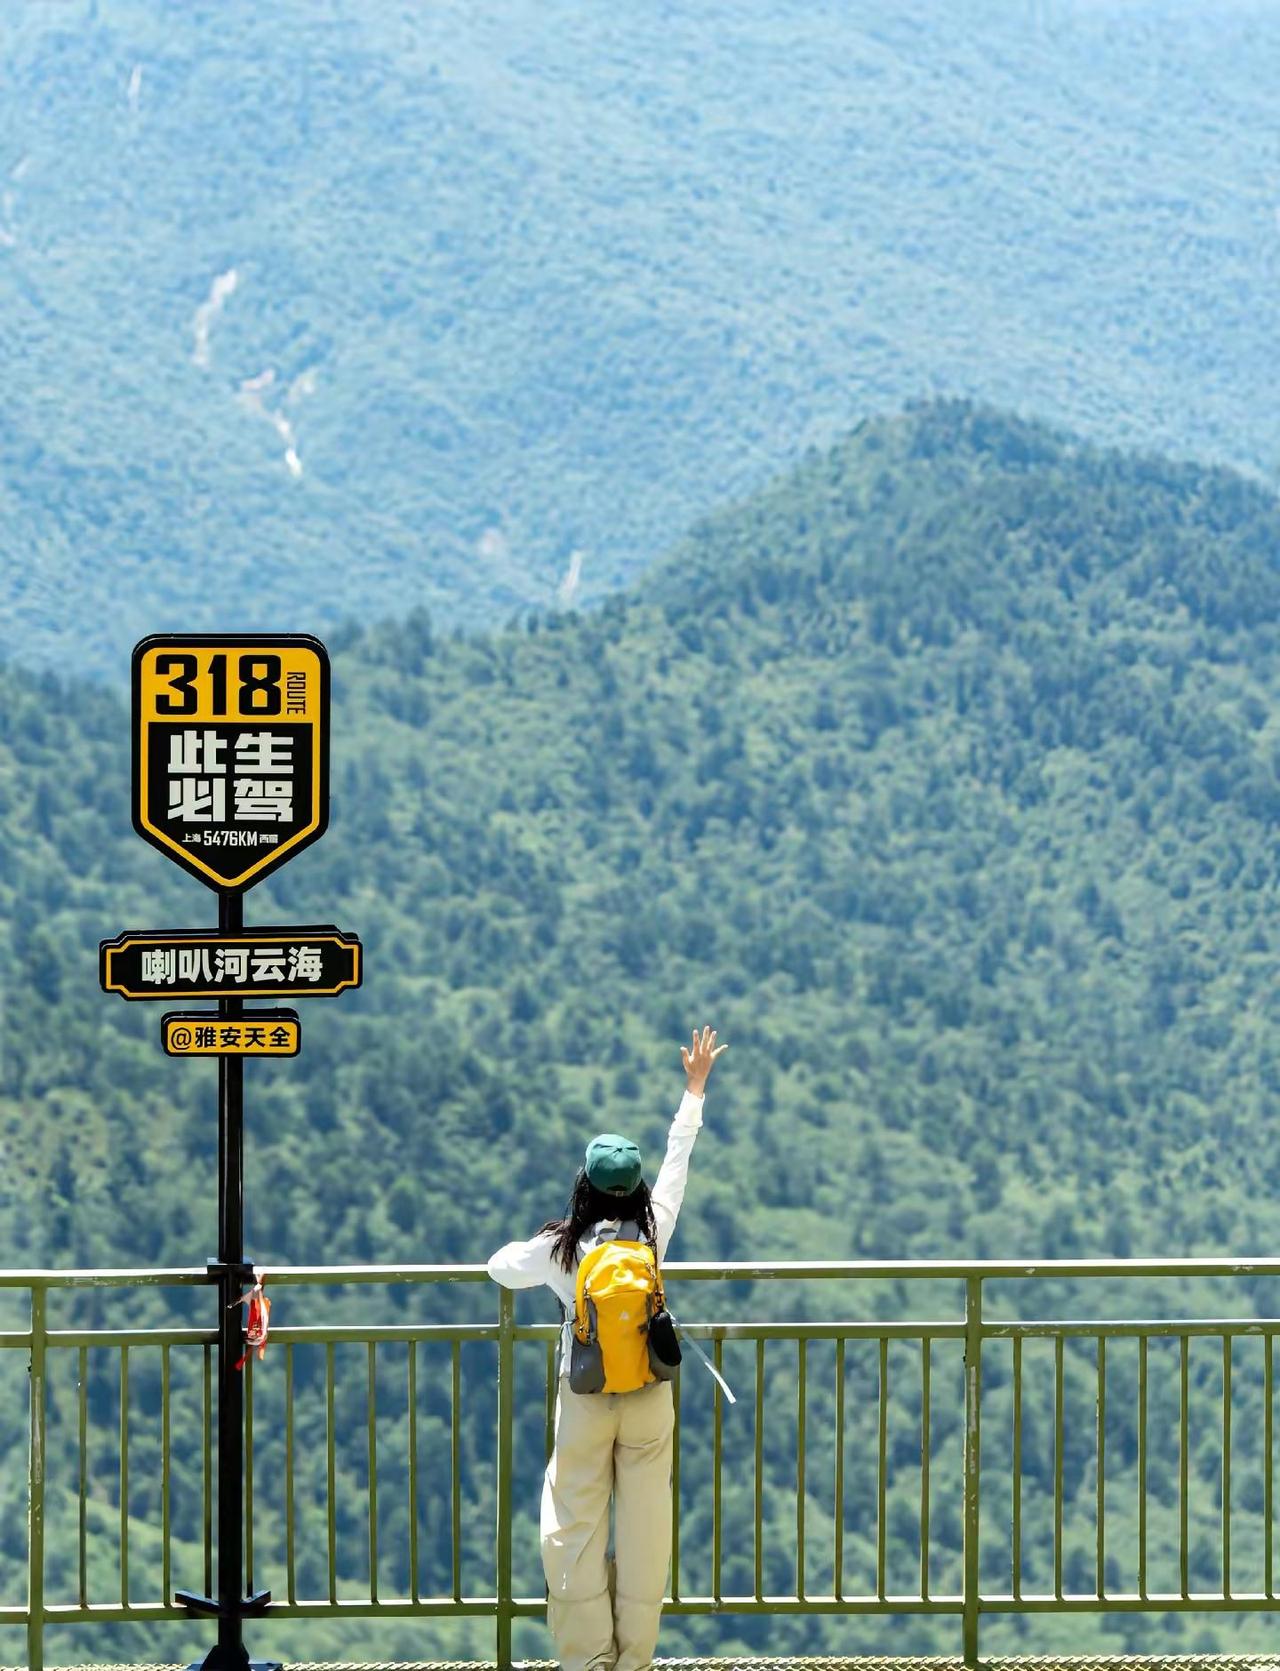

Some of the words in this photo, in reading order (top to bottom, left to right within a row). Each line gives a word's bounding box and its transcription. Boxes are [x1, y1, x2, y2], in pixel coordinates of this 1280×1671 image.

[155, 654, 281, 715] 318
[287, 672, 306, 715] ROUTE
[168, 731, 294, 773] 此生
[168, 778, 294, 822] 必驾
[203, 830, 258, 846] 5476KM
[141, 946, 323, 985] 喇叭河云海
[171, 1026, 291, 1050] @雅安天全
